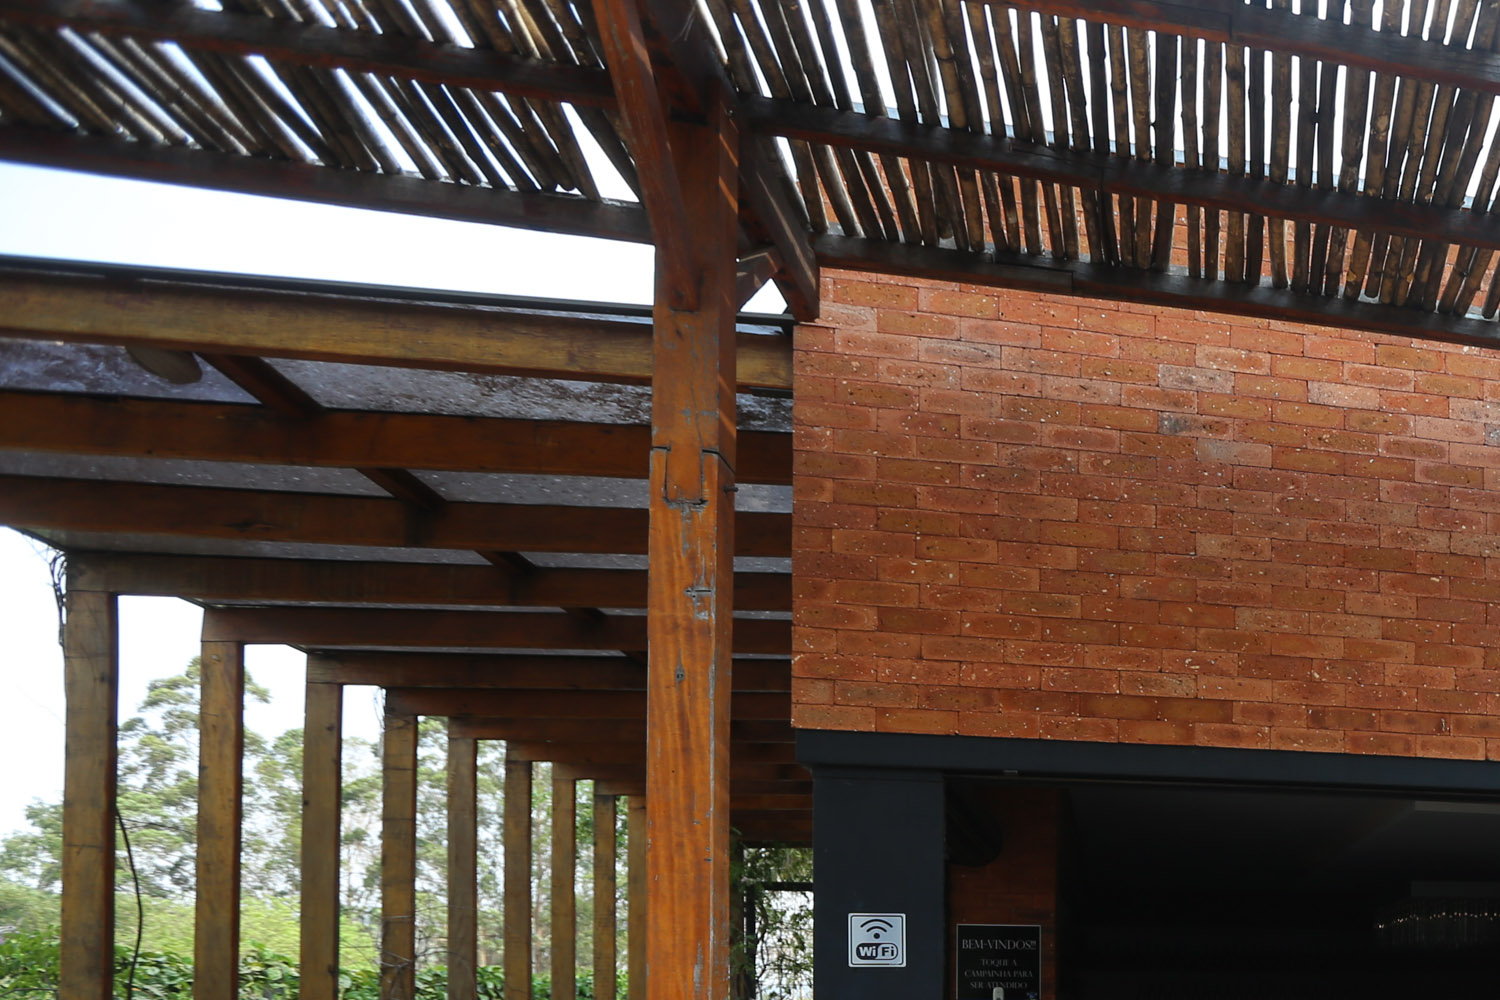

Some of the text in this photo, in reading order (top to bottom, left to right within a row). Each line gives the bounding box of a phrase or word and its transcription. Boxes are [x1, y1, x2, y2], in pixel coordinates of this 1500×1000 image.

[981, 959, 1018, 968] TOQUE A
[964, 969, 1033, 978] CAMPAINHA PARA
